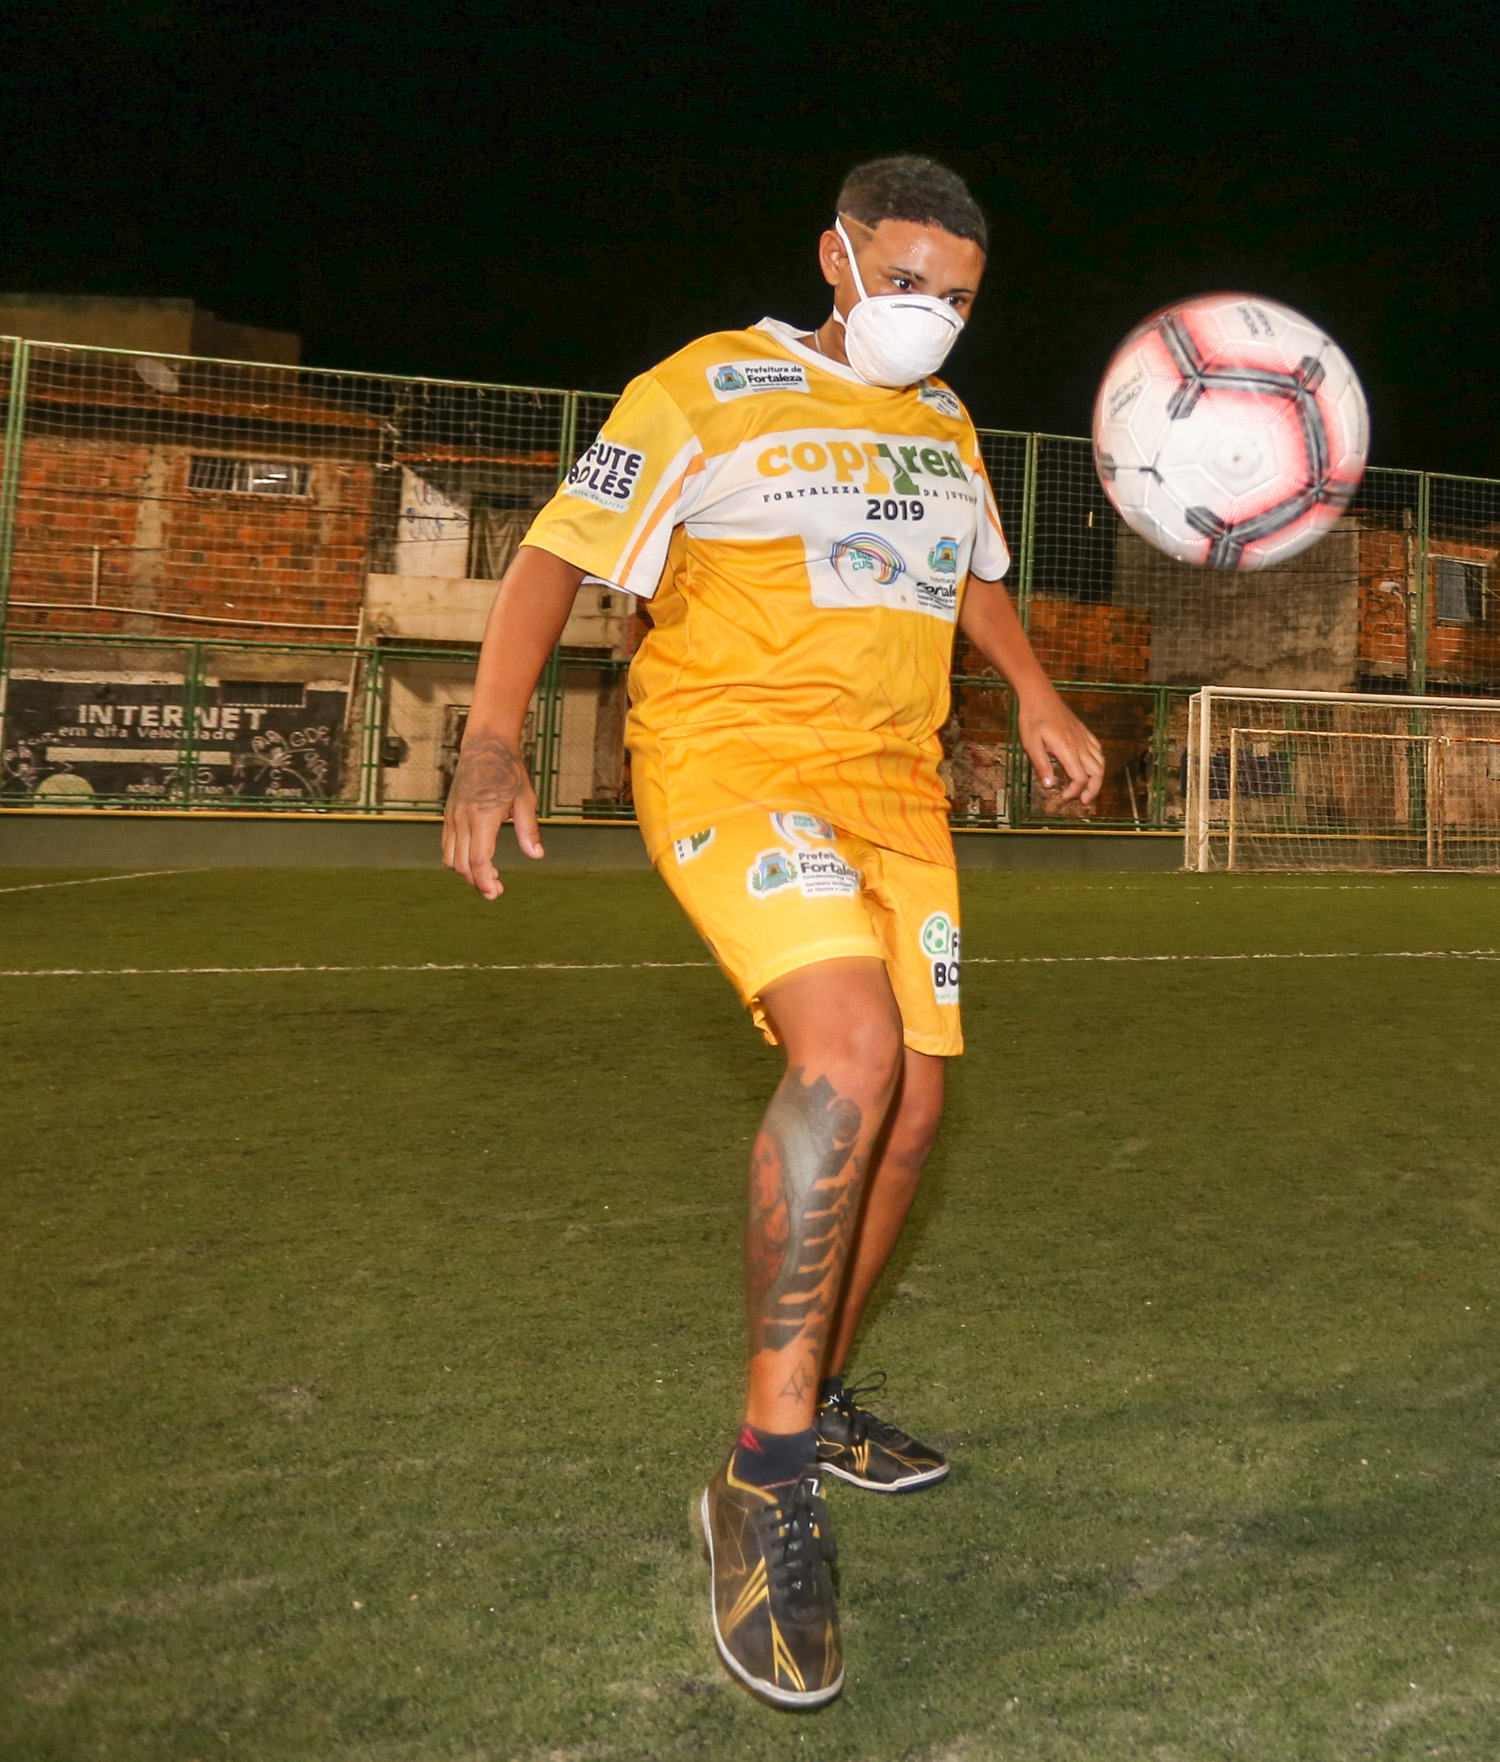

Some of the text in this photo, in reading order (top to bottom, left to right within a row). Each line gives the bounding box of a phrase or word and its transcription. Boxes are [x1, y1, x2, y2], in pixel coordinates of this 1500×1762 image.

[745, 365, 802, 374] Prefeitura de
[747, 373, 803, 383] Fortaleza
[586, 443, 642, 476] FUTE
[763, 486, 860, 503] FORTALEZA
[923, 488, 939, 497] DA
[865, 498, 924, 521] 2019
[916, 582, 956, 597] Fortale
[77, 704, 268, 730] INTERNET
[58, 726, 87, 737] em
